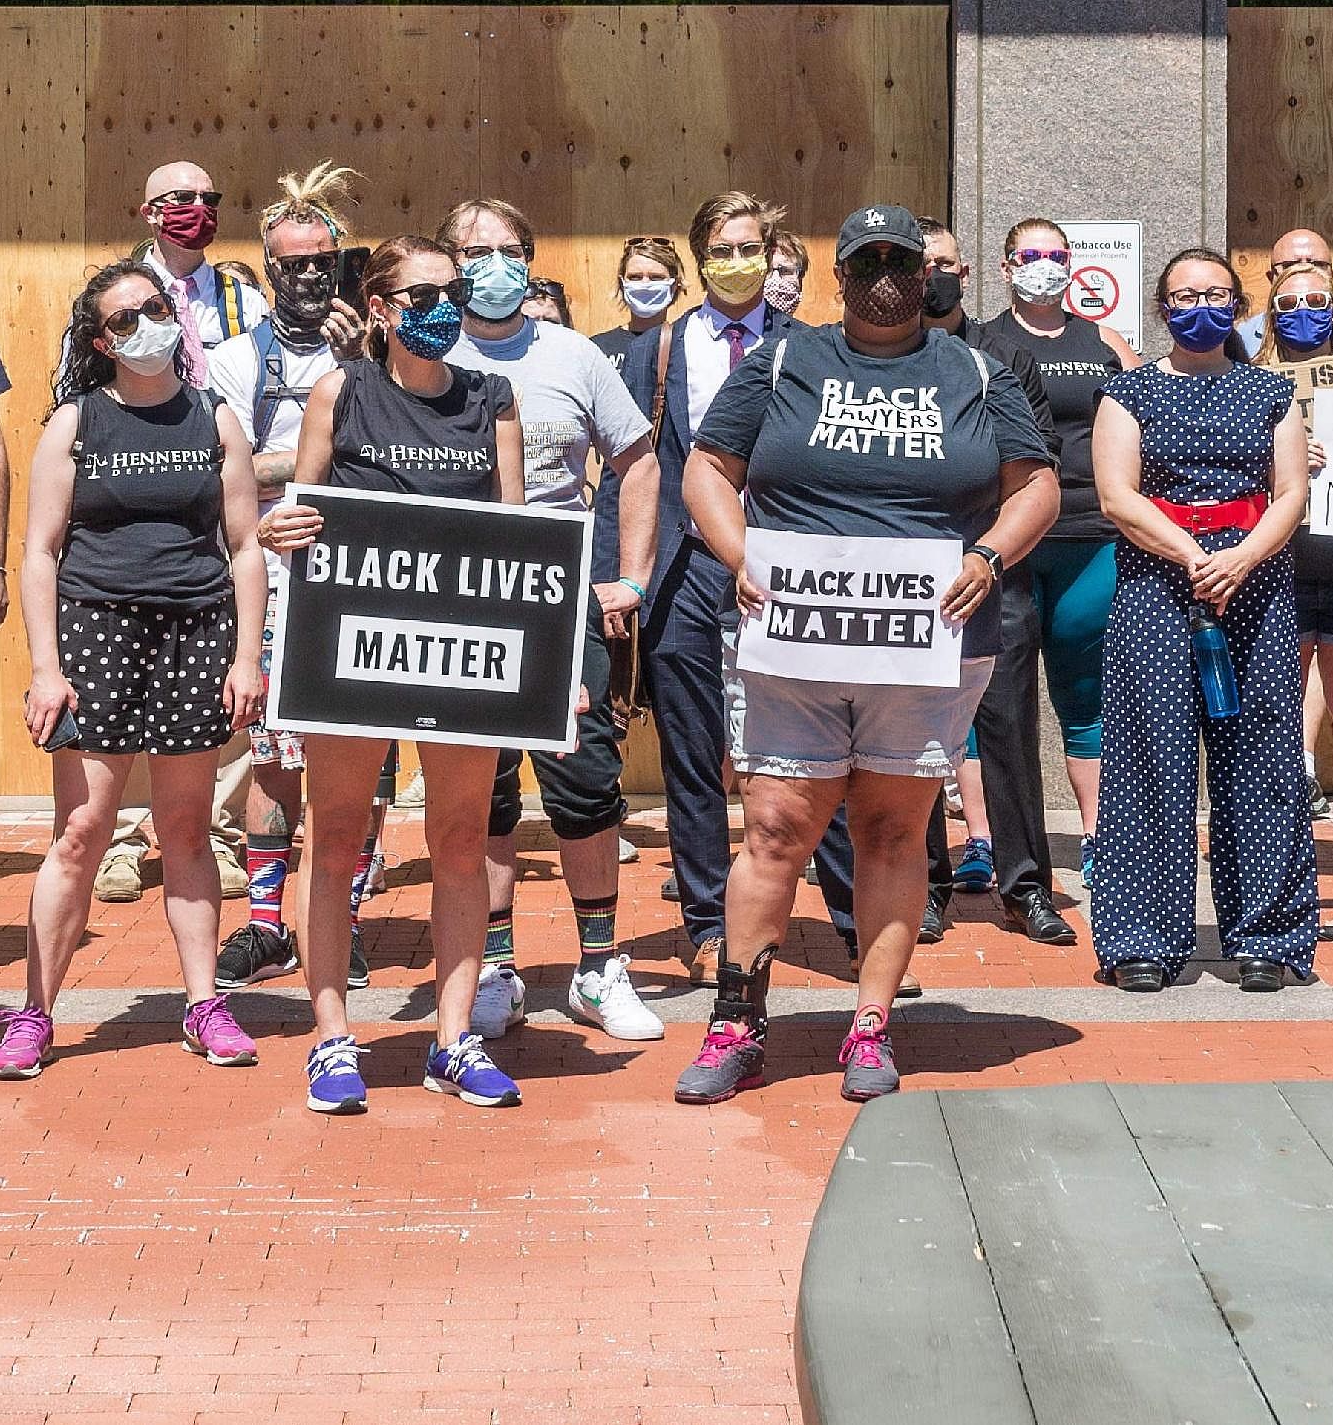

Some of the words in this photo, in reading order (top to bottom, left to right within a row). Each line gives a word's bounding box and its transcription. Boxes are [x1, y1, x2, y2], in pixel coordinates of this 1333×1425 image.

[1069, 240, 1111, 250] Tobacco
[1114, 240, 1133, 250] Use
[1036, 361, 1106, 373] ENNEPIN
[821, 378, 941, 412] BLACK
[825, 400, 938, 429] LAWYERS
[111, 448, 212, 469] HENNEPIN
[388, 444, 488, 465] HENNEPIN
[807, 423, 946, 460] MATTER
[306, 542, 442, 594] BLACK
[458, 555, 566, 606] LIVES
[770, 565, 856, 597] BLACK
[861, 572, 935, 600] LIVES
[770, 605, 932, 643] MATTER
[353, 629, 507, 681] MATTER
